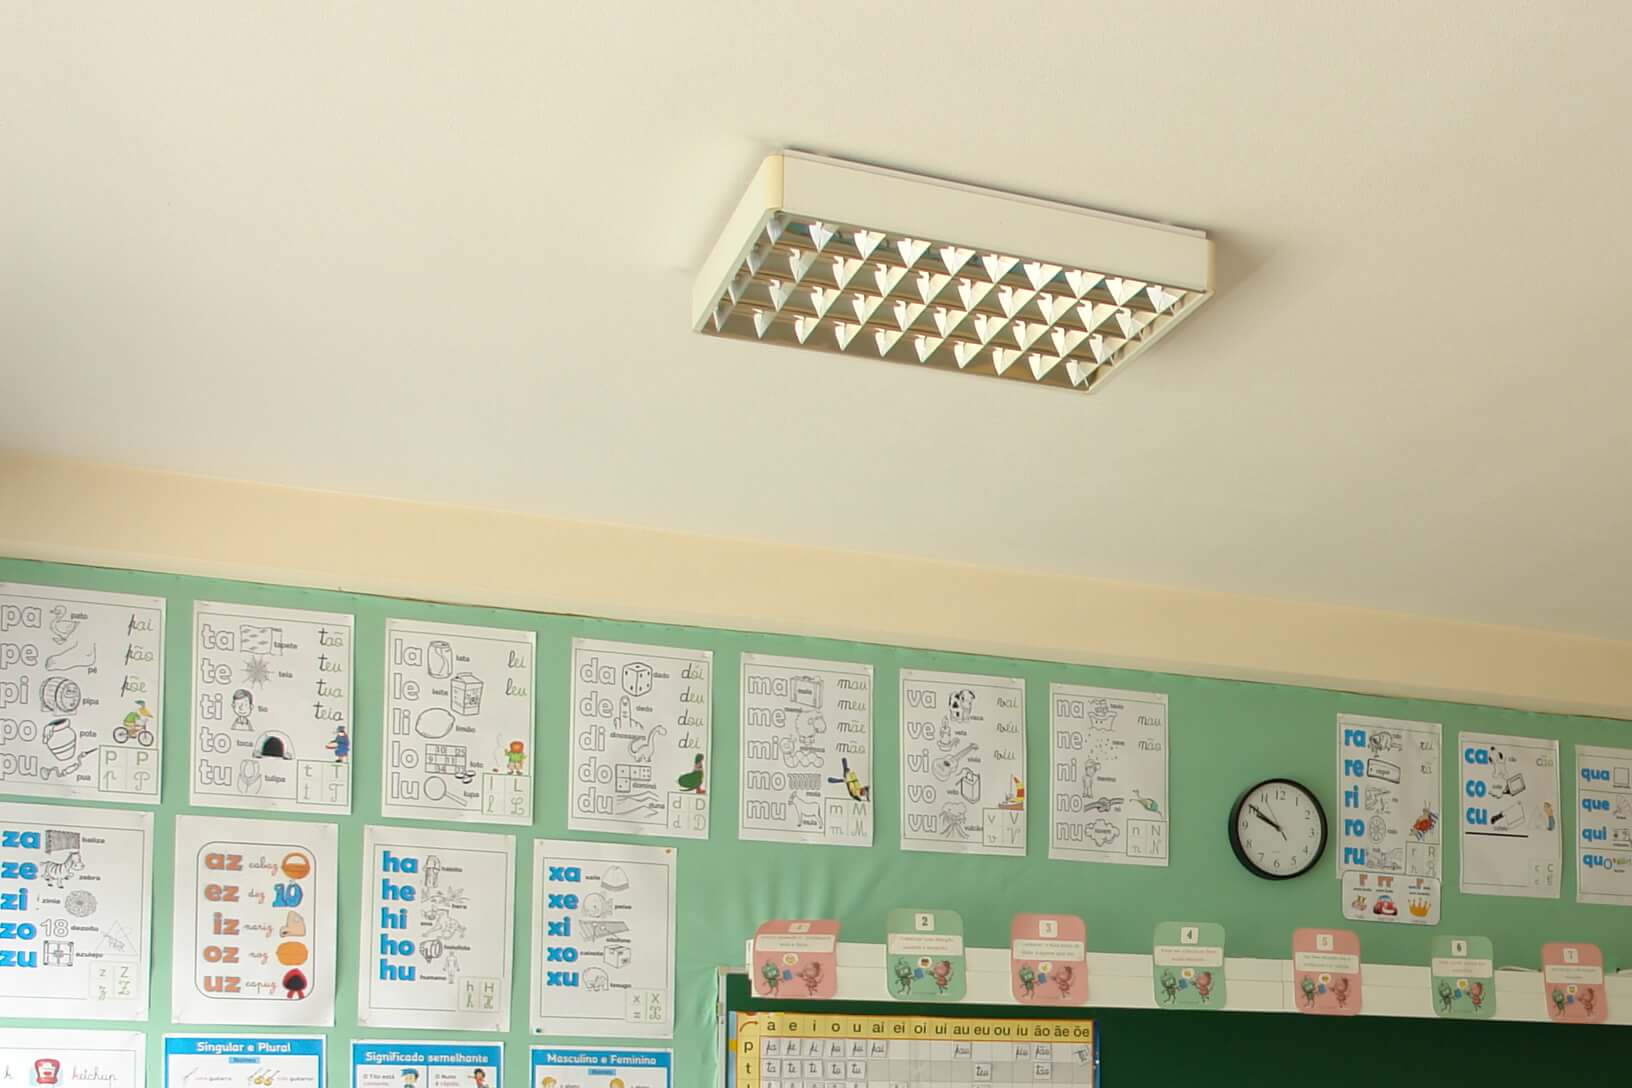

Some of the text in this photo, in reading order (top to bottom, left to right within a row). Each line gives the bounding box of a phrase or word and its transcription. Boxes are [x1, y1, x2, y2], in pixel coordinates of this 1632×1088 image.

[1, 605, 42, 631] pa
[201, 624, 234, 651] ta
[0, 643, 39, 666] pe
[393, 638, 422, 666] la
[200, 658, 232, 684] te
[580, 658, 616, 685] da
[0, 676, 29, 708] pi
[392, 672, 419, 700] le
[748, 673, 788, 697] ma
[200, 693, 223, 720] ti
[579, 691, 613, 718] de
[907, 688, 937, 709] va
[1057, 698, 1084, 719] na
[392, 708, 410, 735] li
[747, 705, 785, 728] me
[0, 714, 38, 743] po
[578, 726, 605, 751] di
[907, 720, 935, 741] ve
[1344, 729, 1366, 748] ra
[199, 727, 231, 753] to
[747, 737, 778, 760] mi
[1057, 730, 1082, 750] ne
[391, 741, 418, 768] lo
[907, 751, 929, 773] vi
[1465, 748, 1489, 764] ca
[0, 753, 38, 783] pu
[199, 759, 232, 786] tu
[578, 757, 612, 783] do
[1057, 759, 1077, 782] ni
[1344, 759, 1364, 777] re
[1581, 768, 1610, 781] qua
[391, 772, 419, 800] lu
[747, 770, 785, 791] mo
[1466, 780, 1486, 797] co
[578, 788, 613, 814] du
[907, 783, 936, 803] vo
[1057, 792, 1083, 812] no
[1275, 790, 1286, 800] 12
[1344, 785, 1359, 808] ri
[747, 799, 785, 821] mu
[1304, 811, 1311, 819] 2
[1581, 798, 1610, 812] que
[907, 812, 937, 834] vu
[1242, 821, 1248, 829] 9
[1466, 808, 1488, 824] cu
[1057, 820, 1083, 841] nu
[1344, 819, 1364, 836] ro
[1582, 827, 1607, 841] qui
[1, 830, 41, 849] za
[205, 853, 242, 871] az
[382, 851, 418, 874] ha
[1274, 859, 1280, 868] 6
[1344, 848, 1365, 865] ru
[1, 861, 39, 880] ze
[549, 866, 581, 883] xa
[1, 888, 29, 911] zi
[204, 883, 240, 902] ez
[272, 882, 303, 908] 10
[381, 879, 416, 901] he
[548, 893, 578, 910] xe
[213, 912, 240, 935] iz
[381, 907, 407, 929] hi
[548, 917, 571, 937] xi
[921, 917, 928, 927] 2
[0, 922, 37, 940] zo
[204, 946, 239, 963] oz
[380, 934, 415, 956] ho
[547, 946, 578, 963] xo
[0, 950, 38, 968] zu
[379, 959, 416, 981] hu
[547, 970, 579, 987] xu
[204, 975, 241, 992] uz
[767, 1021, 1089, 1036] a e i o u ai ei oi ui au eu ou iu ão ãe õe
[197, 1041, 244, 1054] Singular
[258, 1041, 291, 1052] Plural
[366, 1051, 488, 1064] Significado semelhante
[547, 1054, 657, 1065] Masculino e Feminino
